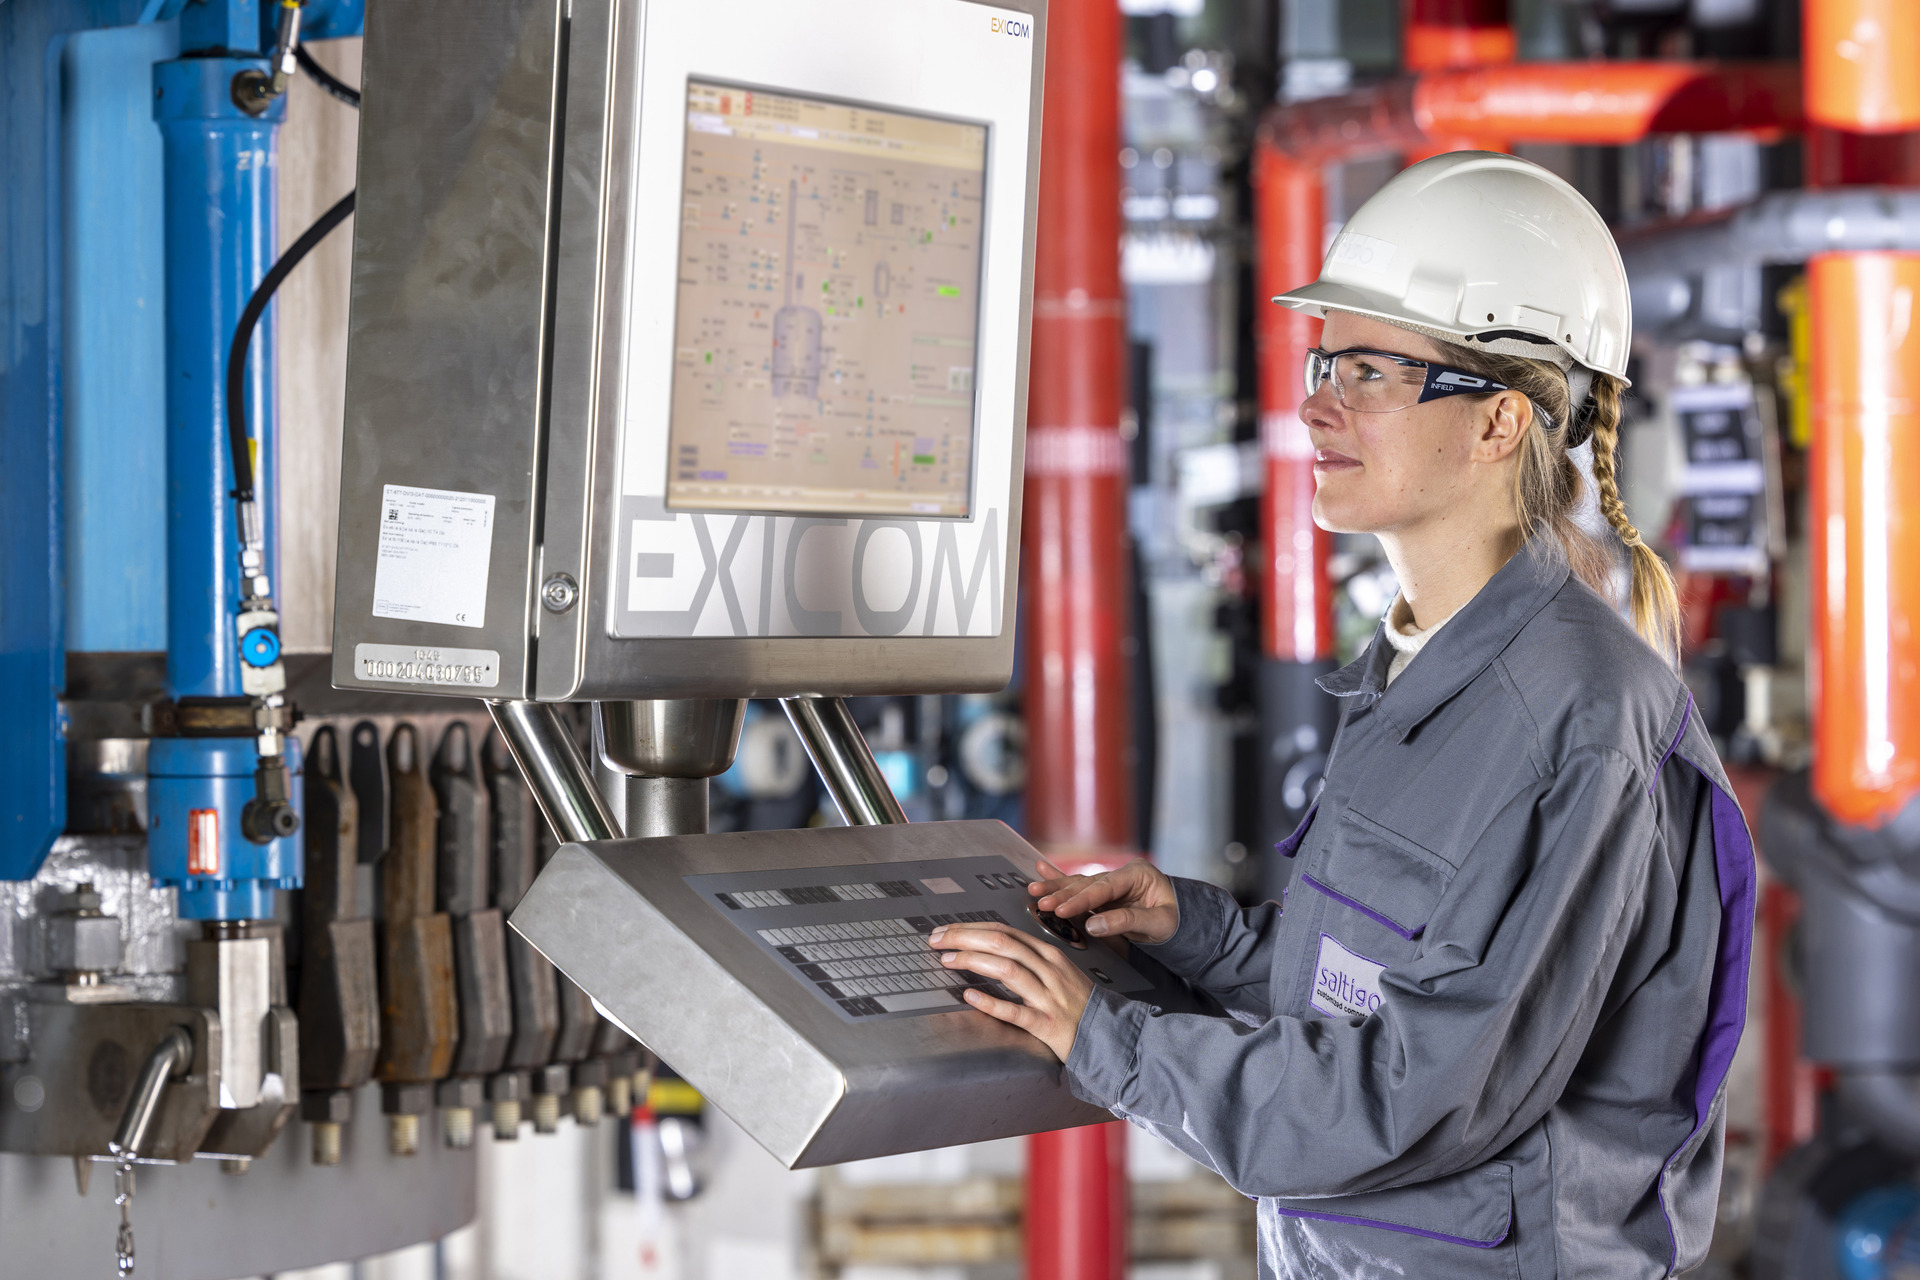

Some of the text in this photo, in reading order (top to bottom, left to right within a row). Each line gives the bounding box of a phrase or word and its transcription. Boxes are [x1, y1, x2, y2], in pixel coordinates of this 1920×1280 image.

[991, 17, 1029, 39] EXICOM
[1431, 383, 1454, 392] INFIELD
[616, 495, 1001, 636] EXICOM
[1319, 967, 1381, 1012] saltigo
